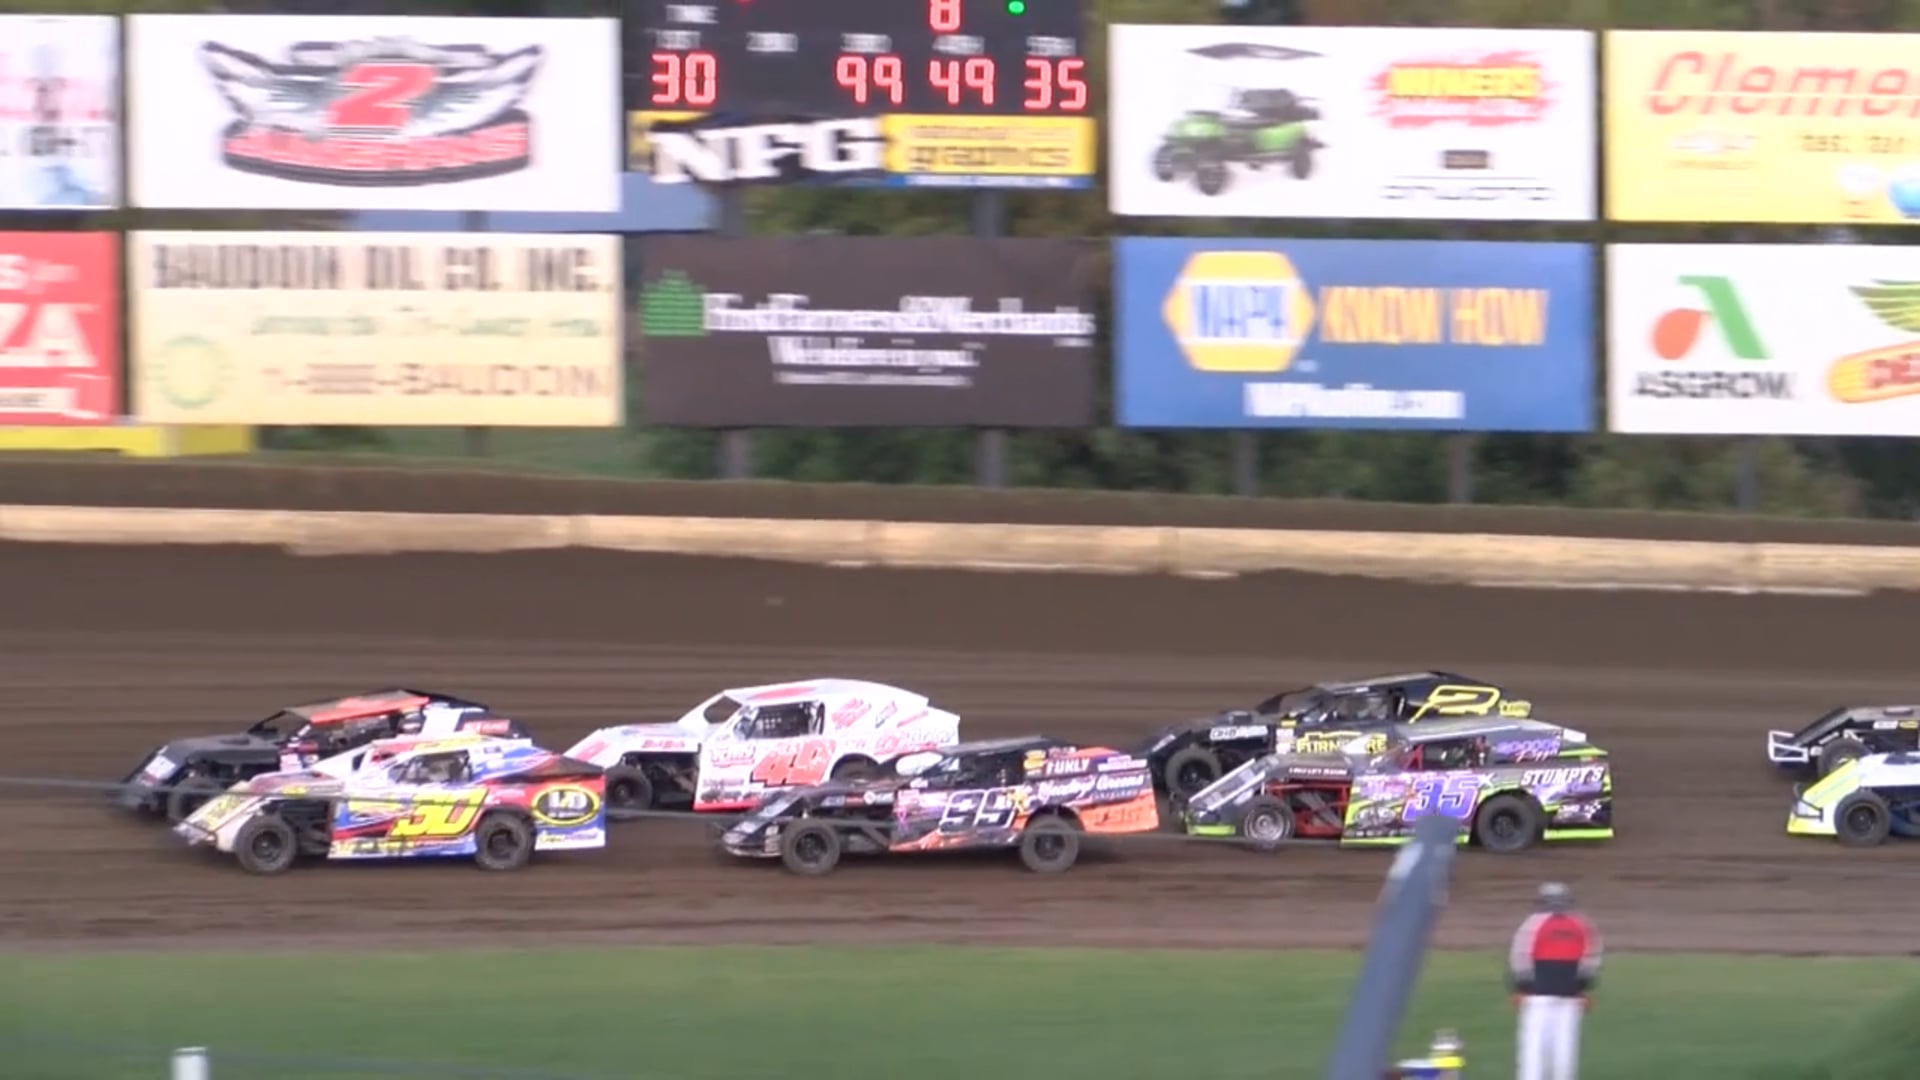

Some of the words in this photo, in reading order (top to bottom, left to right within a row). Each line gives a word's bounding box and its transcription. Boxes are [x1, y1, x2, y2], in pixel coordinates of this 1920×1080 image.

[322, 63, 440, 127] 2
[652, 54, 716, 104] 30
[836, 56, 903, 104] 99
[929, 58, 994, 105] 49
[1024, 59, 1087, 109] 35
[1319, 286, 1442, 344] KNOW
[1450, 288, 1548, 345] HOW
[1631, 370, 1799, 400] ASGROW
[1520, 766, 1604, 786] STUMPY'S
